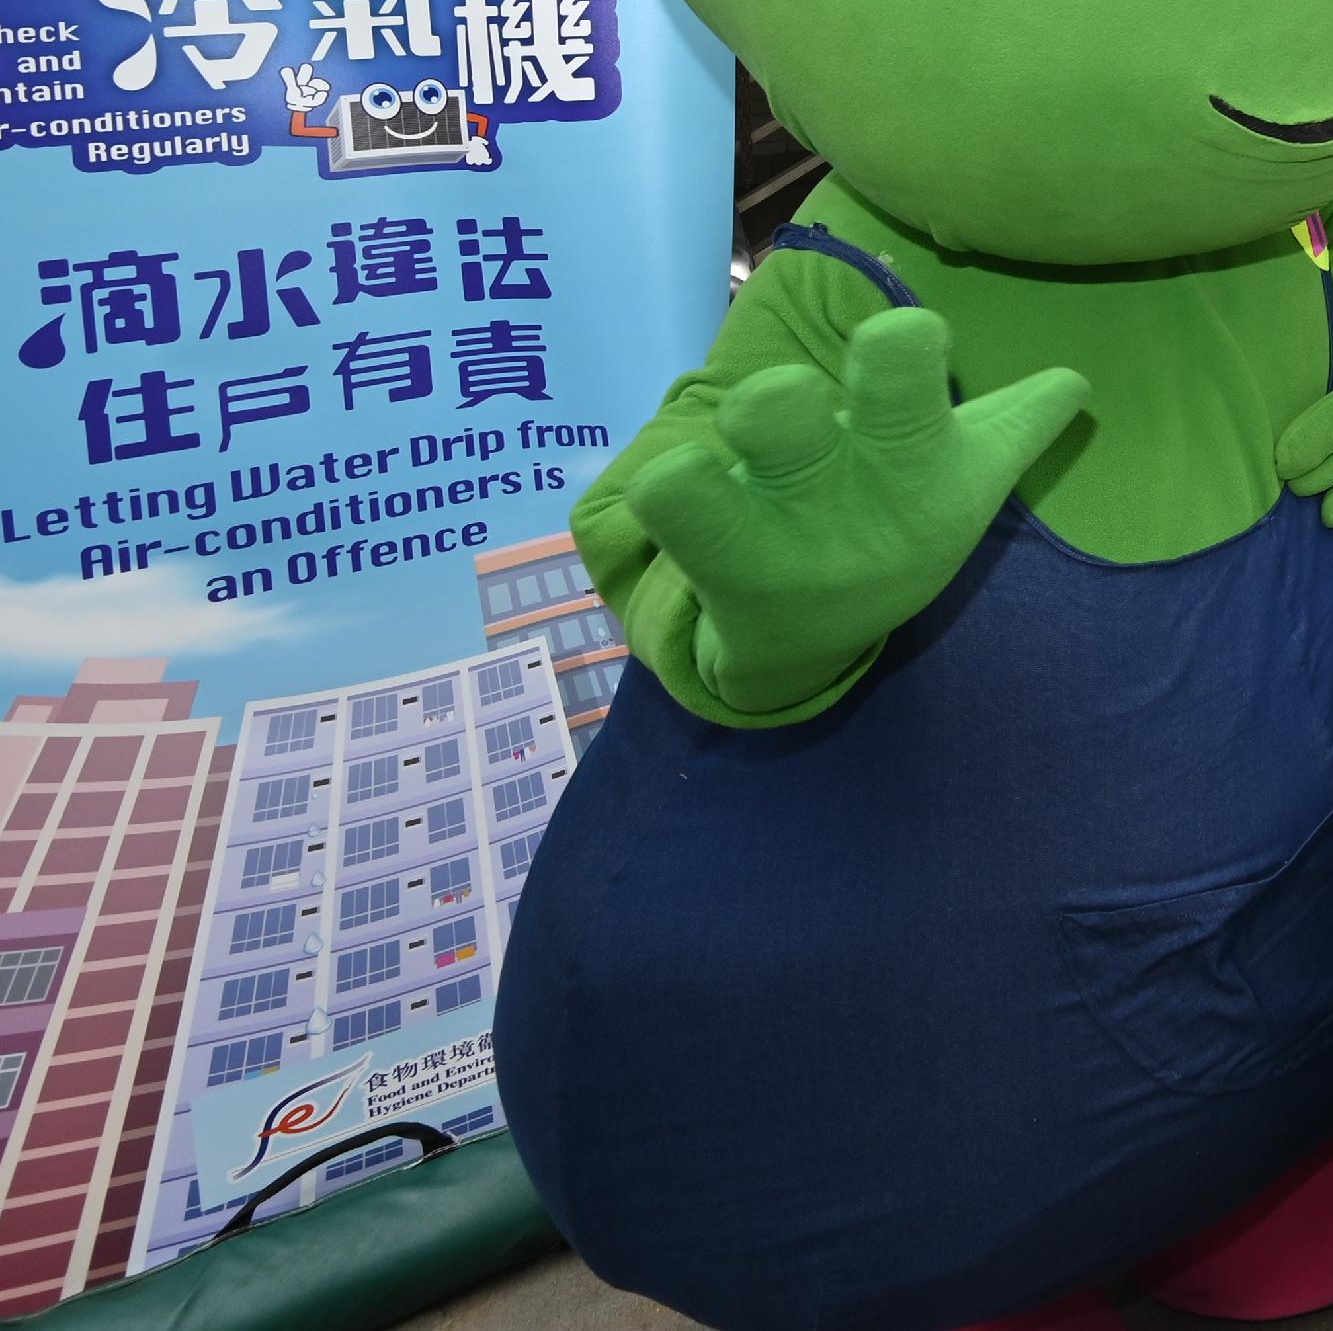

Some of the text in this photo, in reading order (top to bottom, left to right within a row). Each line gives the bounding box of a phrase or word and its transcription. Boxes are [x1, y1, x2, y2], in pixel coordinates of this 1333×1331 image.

[0, 21, 80, 45] heck
[16, 50, 82, 74] and
[0, 81, 85, 105] ntain
[0, 106, 247, 141] r-conditioners
[87, 132, 250, 165] Regularly
[18, 216, 554, 369] 滴水違法
[77, 319, 555, 466] 住戶有責
[1, 418, 610, 545] Letting Water Drip from
[79, 462, 566, 581] Air-conditioners is
[205, 519, 489, 605] an Offence
[367, 1072, 440, 1107] Food and
[368, 1089, 434, 1119] Hygiene
